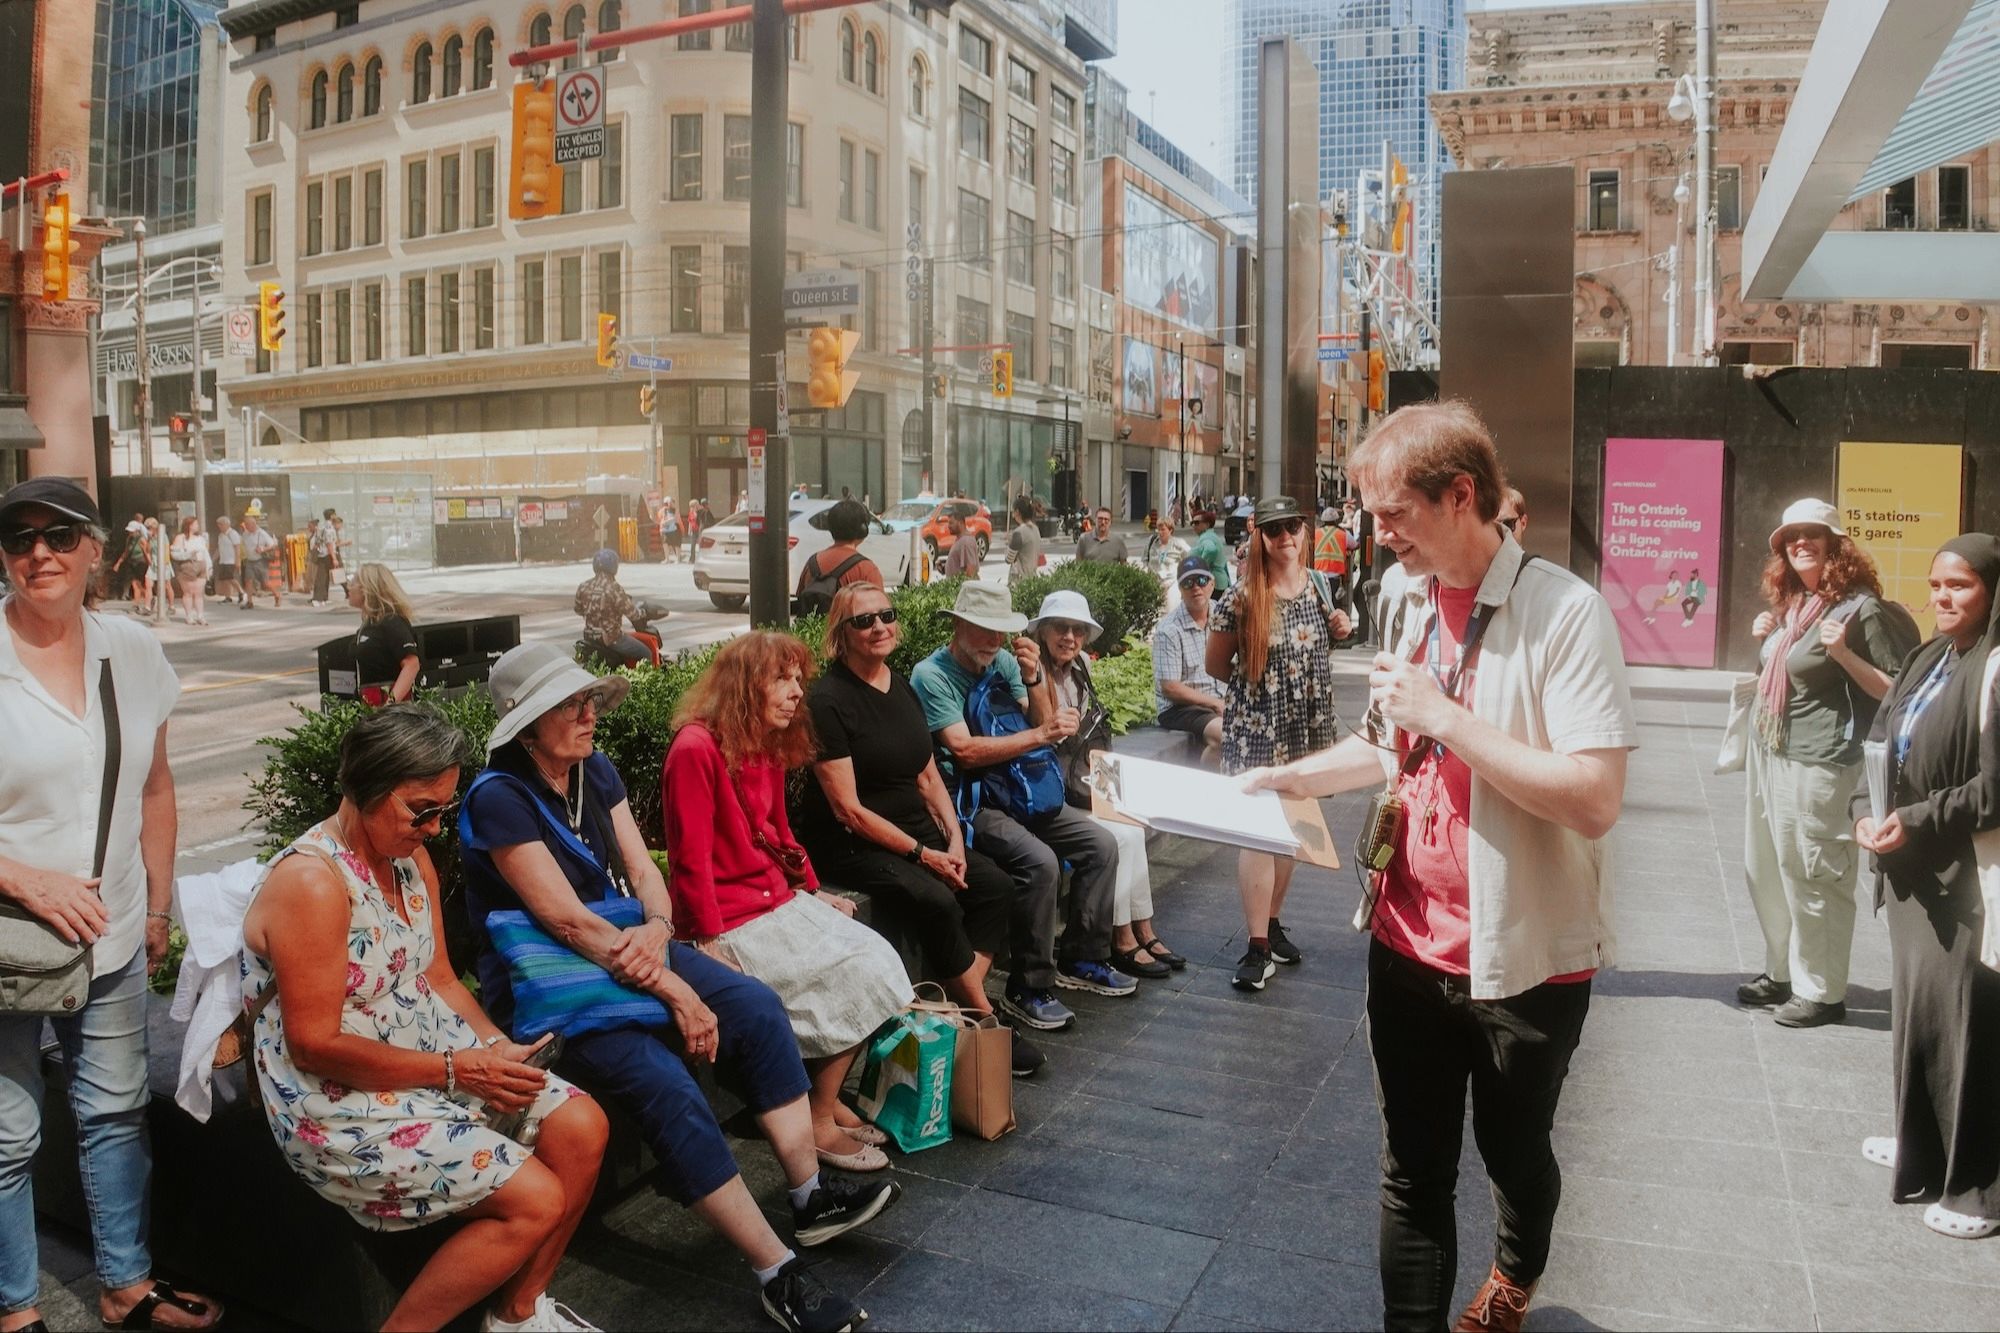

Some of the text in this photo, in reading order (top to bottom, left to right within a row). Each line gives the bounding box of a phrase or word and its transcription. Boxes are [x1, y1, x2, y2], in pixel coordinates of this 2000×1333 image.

[556, 131, 601, 149] TTC VEHICLES
[558, 144, 599, 160] EXCEPTED
[793, 287, 849, 305] Queen St E
[106, 343, 194, 372] HAR ROSEN
[1320, 350, 1341, 359] ueen
[521, 511, 543, 521] STOP
[1612, 502, 1688, 516] The Ontario
[1846, 509, 1920, 523] 15 stations
[1612, 515, 1701, 532] Line is coming
[1610, 532, 1661, 547] La ligne
[1846, 526, 1903, 541] 15 gares
[1610, 545, 1699, 560] Ontario arrive
[920, 1056, 947, 1138] Rexall
